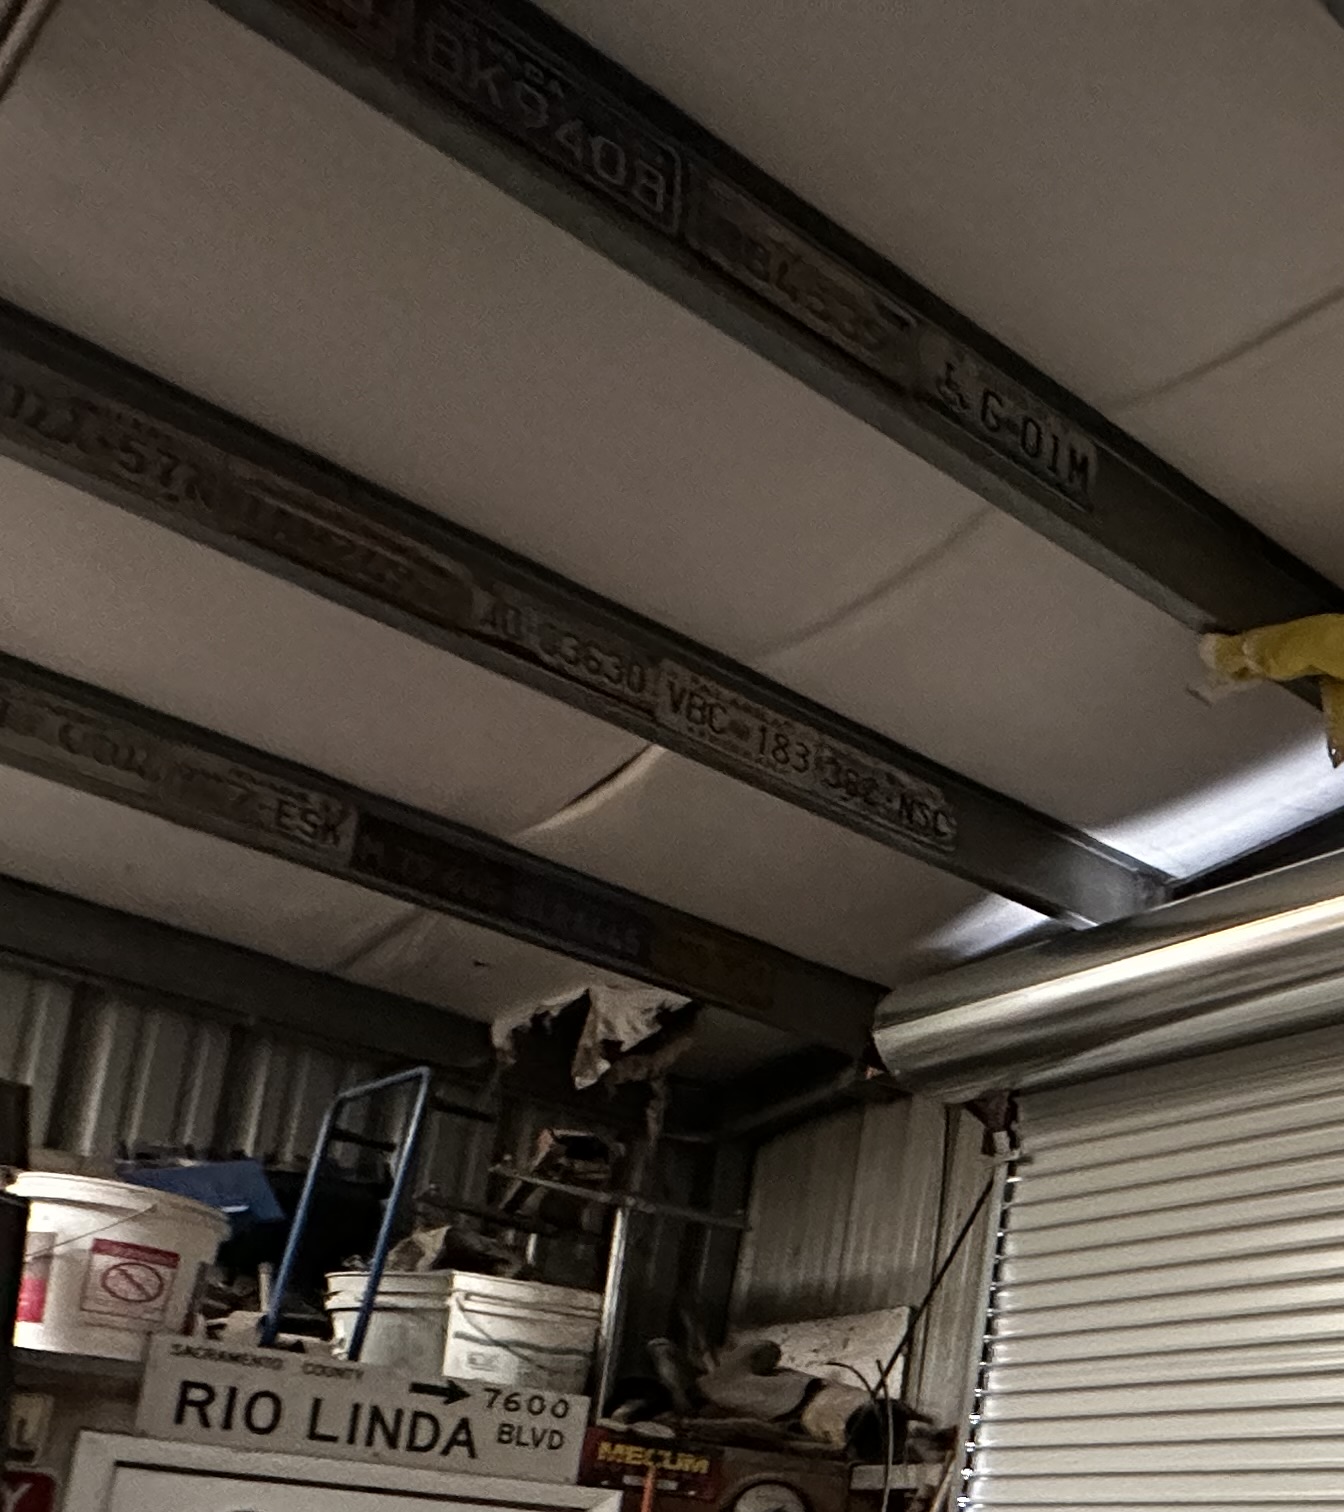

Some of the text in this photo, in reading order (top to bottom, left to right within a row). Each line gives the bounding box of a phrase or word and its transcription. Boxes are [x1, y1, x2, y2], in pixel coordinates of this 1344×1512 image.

[169, 1343, 365, 1381] SACRAMENTO COUNTY
[174, 1380, 570, 1459] RIO LINDA 7600
[496, 1423, 566, 1451] BLVD
